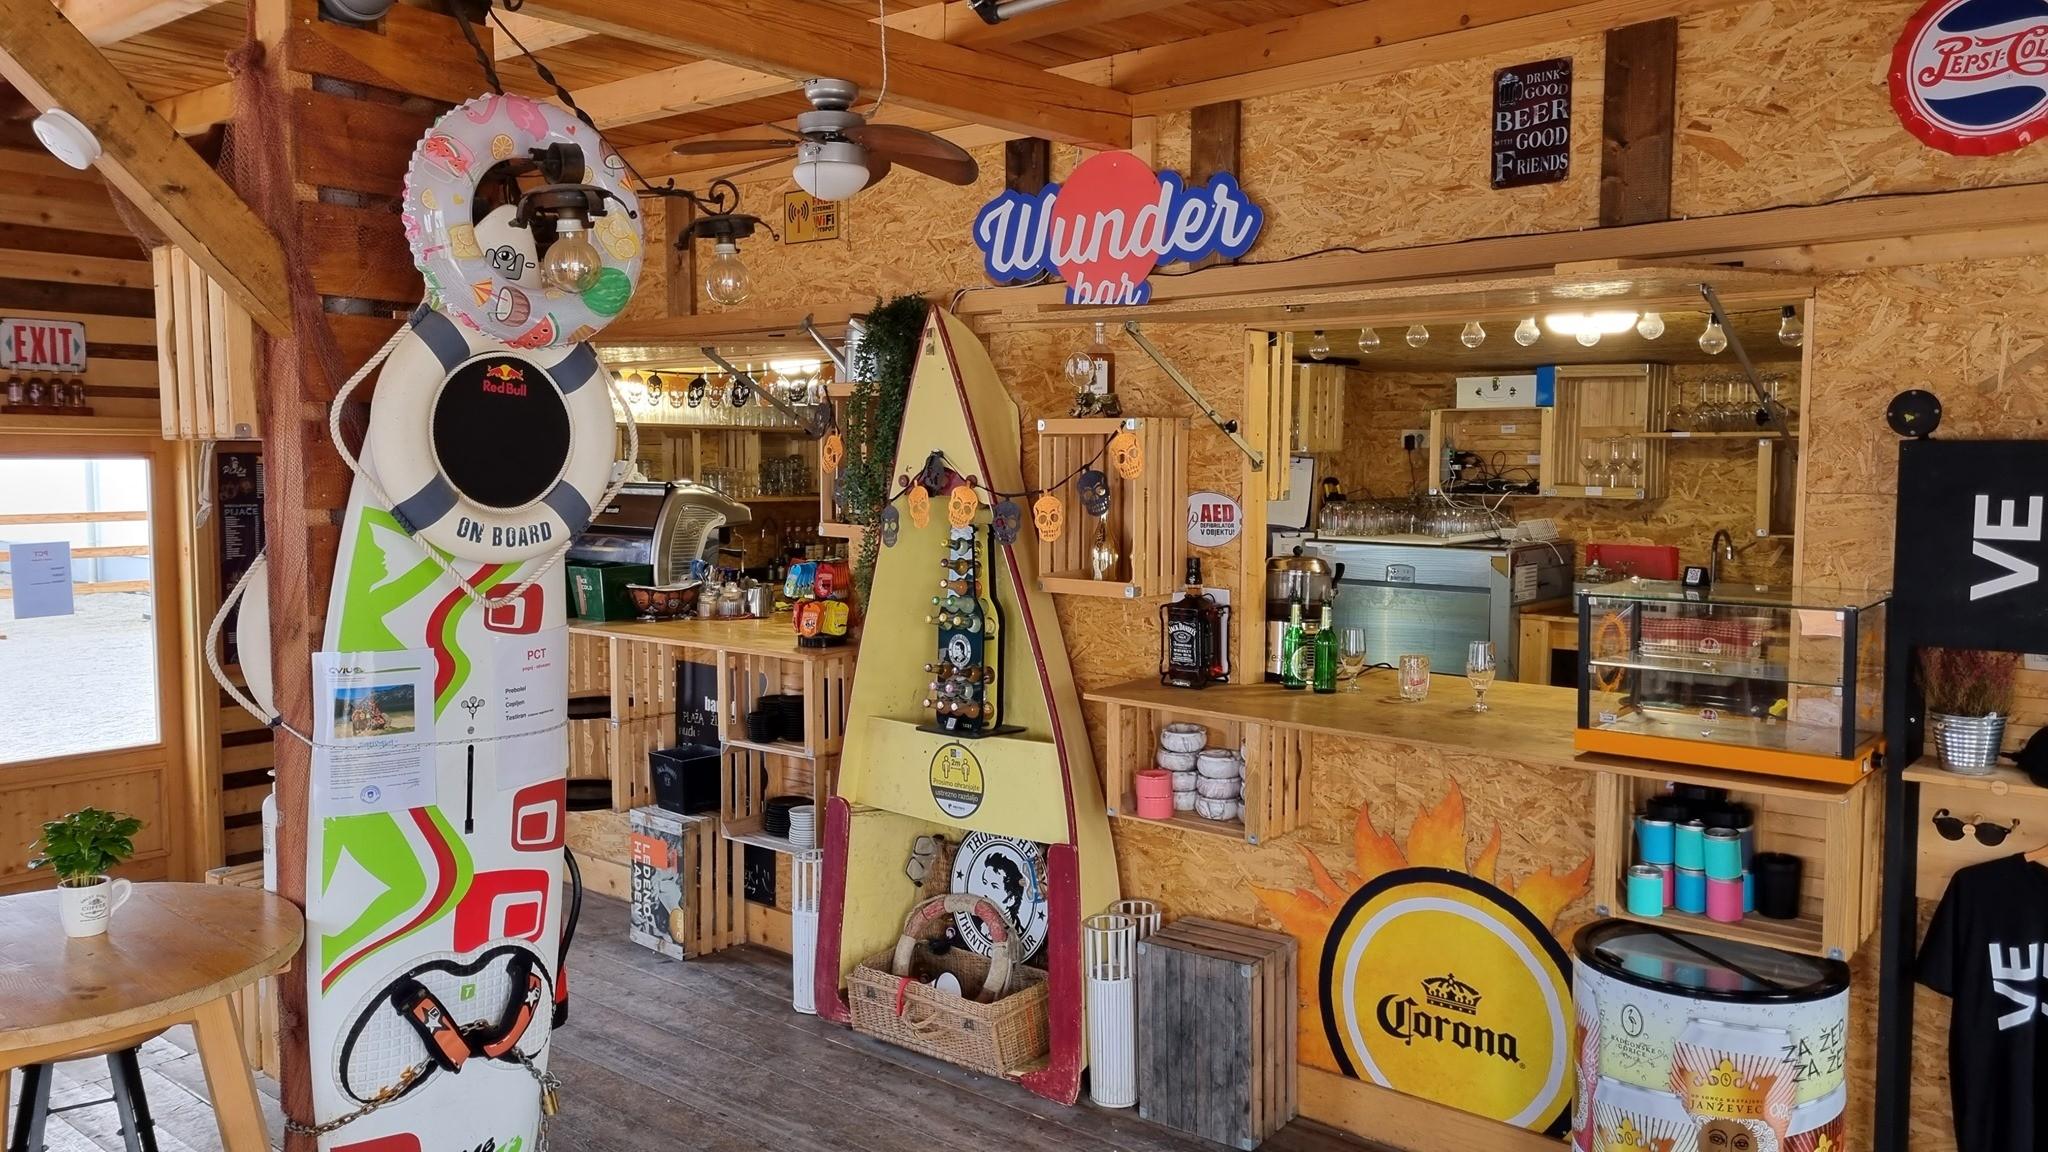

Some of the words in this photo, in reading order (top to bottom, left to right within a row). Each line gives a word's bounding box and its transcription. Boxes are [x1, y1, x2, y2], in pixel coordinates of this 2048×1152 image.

[1918, 25, 2048, 87] PEPSI-COL
[1527, 69, 1560, 84] DRINK
[1525, 83, 1568, 99] GOOD
[1496, 99, 1569, 132] BEER
[1516, 126, 1568, 149] GOOD
[1495, 151, 1568, 182] FRIENDS
[980, 181, 1253, 273] Wunder
[1073, 271, 1142, 305] bar
[13, 325, 72, 364] EXIT
[482, 379, 504, 393] Red
[506, 383, 527, 396] Bull
[1200, 504, 1235, 522] AED
[456, 517, 485, 544] ON
[492, 521, 552, 547] BOARD
[1969, 494, 2044, 601] VE
[527, 648, 547, 660] PCT
[951, 758, 960, 766] 2m
[933, 777, 953, 787] Prosimo
[1988, 943, 2039, 1031] VE
[1376, 993, 1521, 1063] Corona
[1781, 1037, 1812, 1064] ZA
[1792, 1058, 1820, 1083] ZA
[1690, 1100, 1765, 1115] JANŽEVEC
